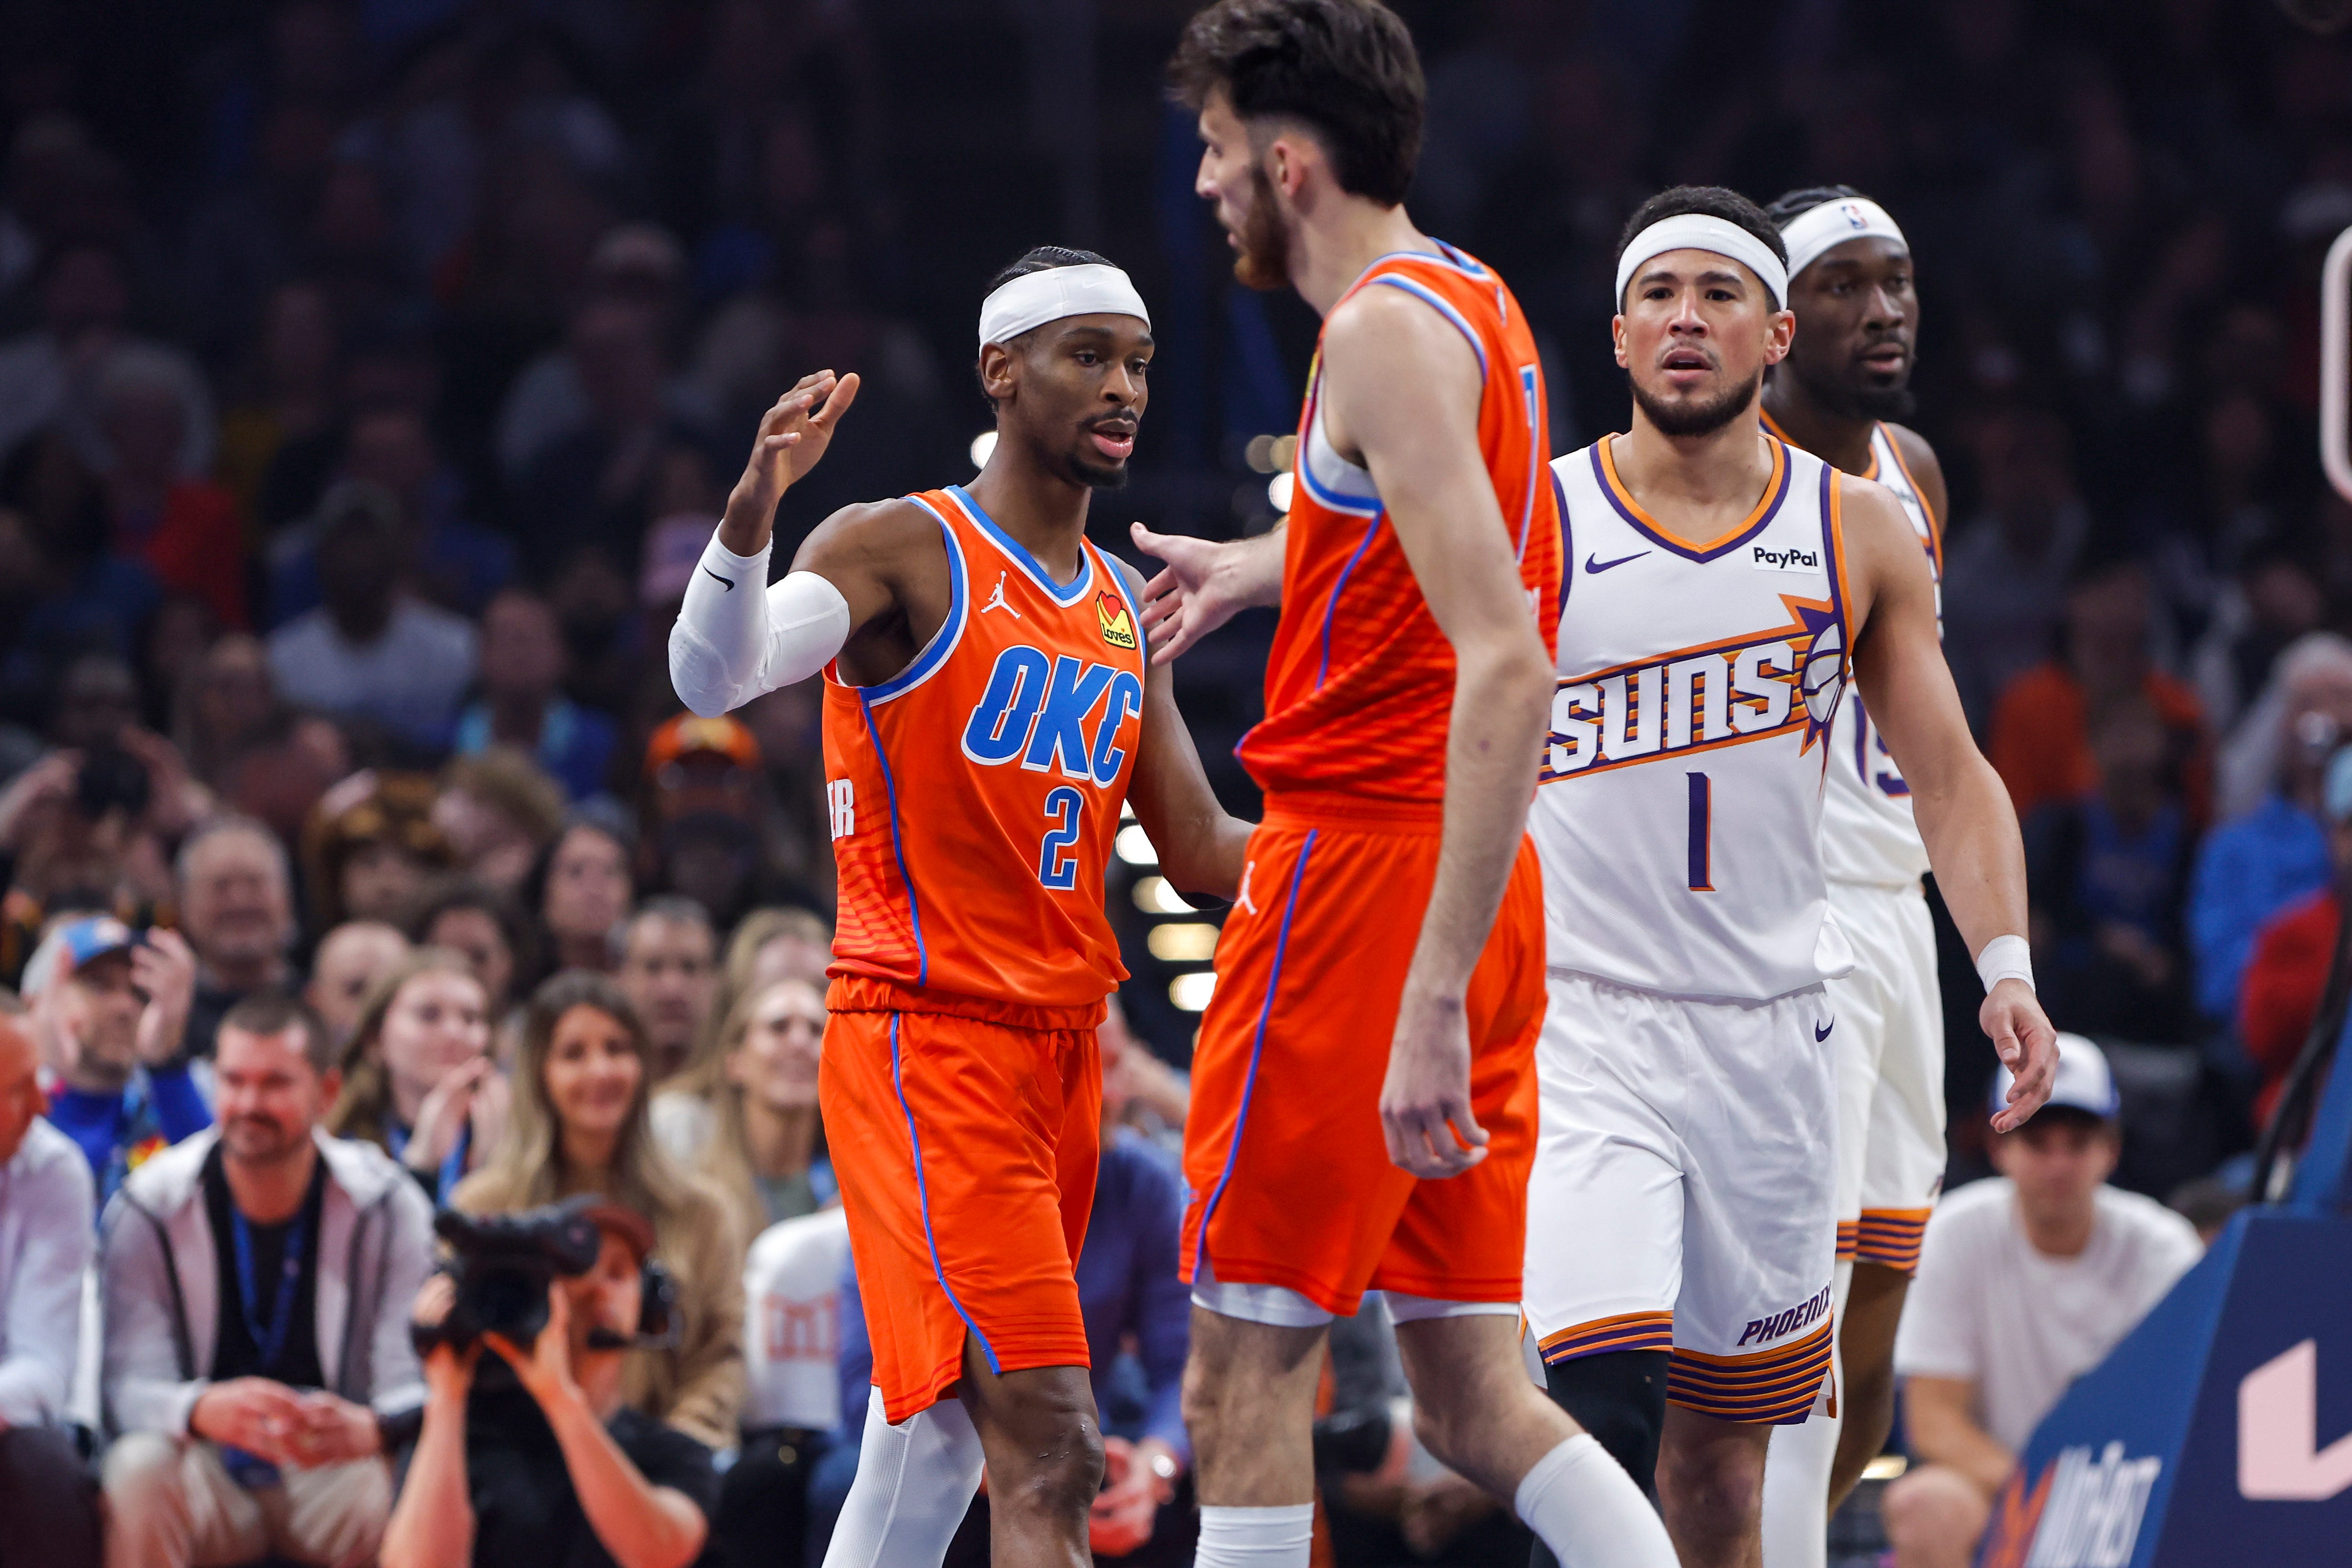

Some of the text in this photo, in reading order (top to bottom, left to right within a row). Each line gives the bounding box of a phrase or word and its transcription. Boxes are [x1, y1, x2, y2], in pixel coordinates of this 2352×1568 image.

[1753, 547, 1818, 569] PayPal
[961, 645, 1144, 788] OKC
[1550, 642, 1794, 773] SUNS
[1040, 785, 1084, 891] 2
[1685, 772, 1715, 891] 1
[1736, 1280, 1832, 1347] PHOENIX
